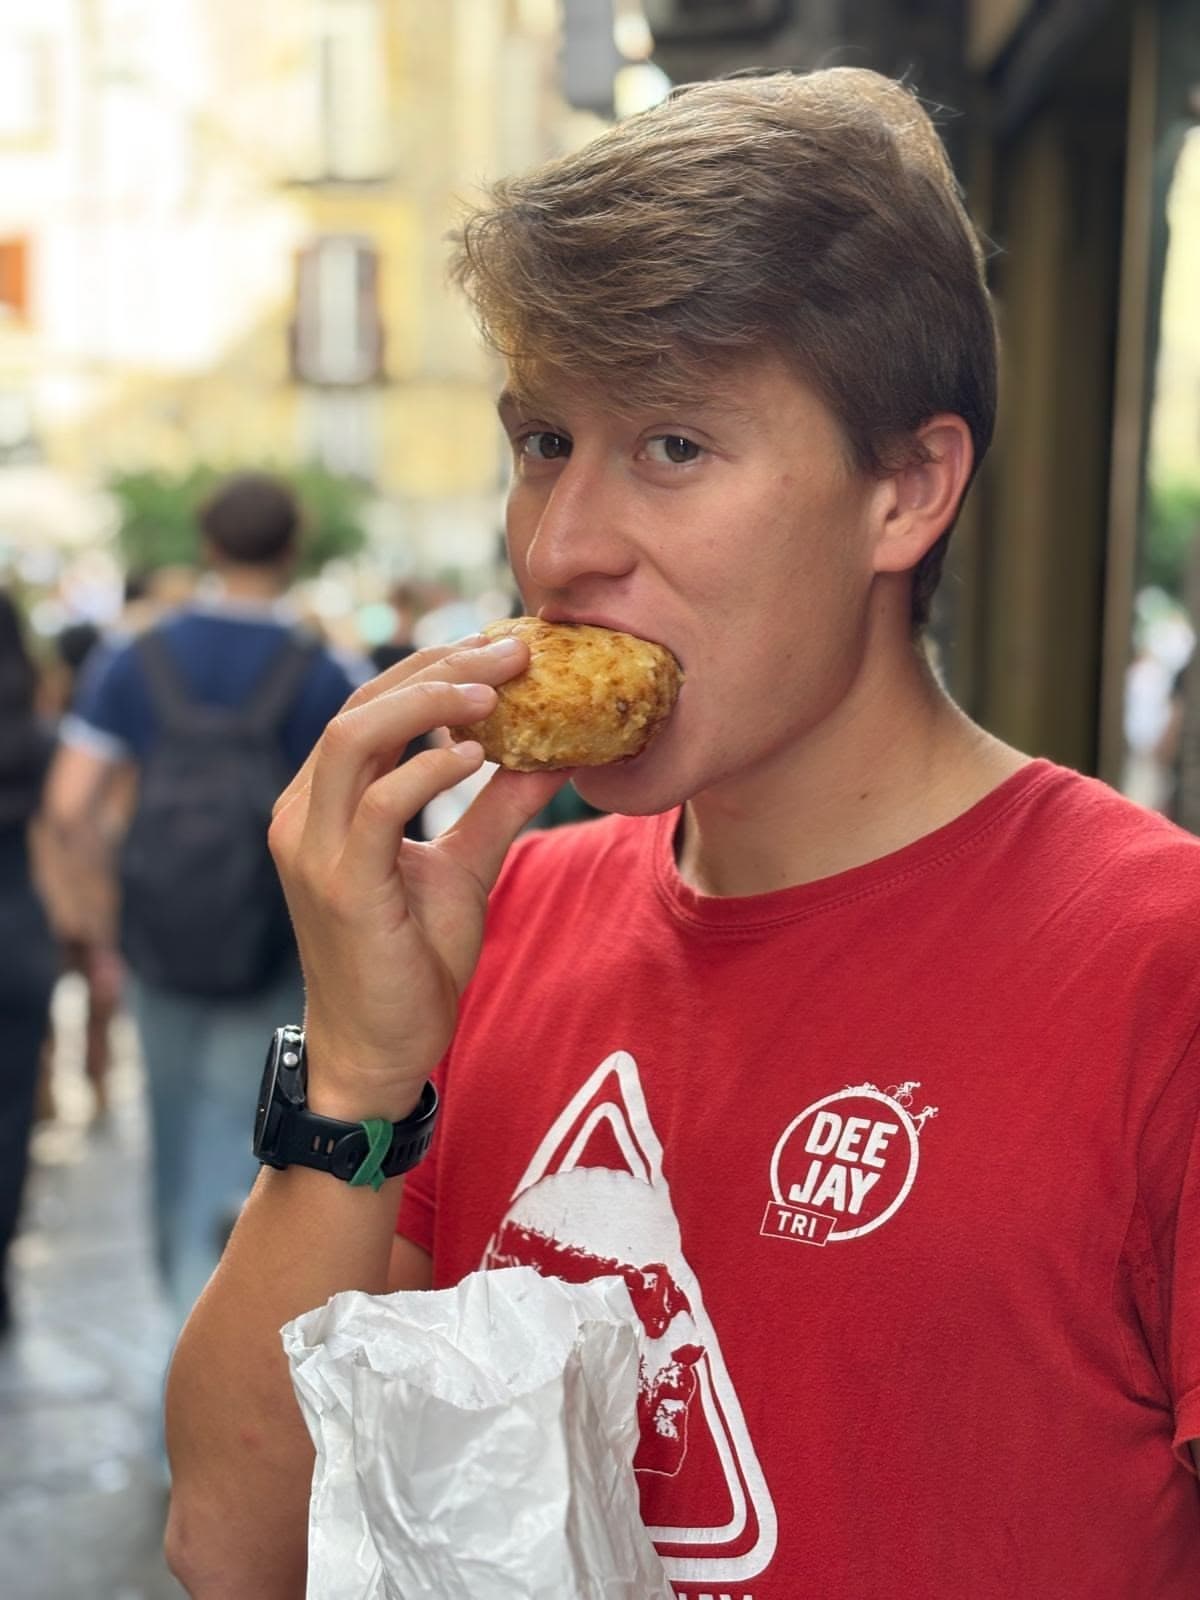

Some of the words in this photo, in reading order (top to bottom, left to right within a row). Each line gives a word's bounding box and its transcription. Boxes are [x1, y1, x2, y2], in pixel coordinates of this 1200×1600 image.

[805, 1111, 898, 1168] DEE
[788, 1160, 881, 1215] JAY
[777, 1210, 817, 1238] TRI
